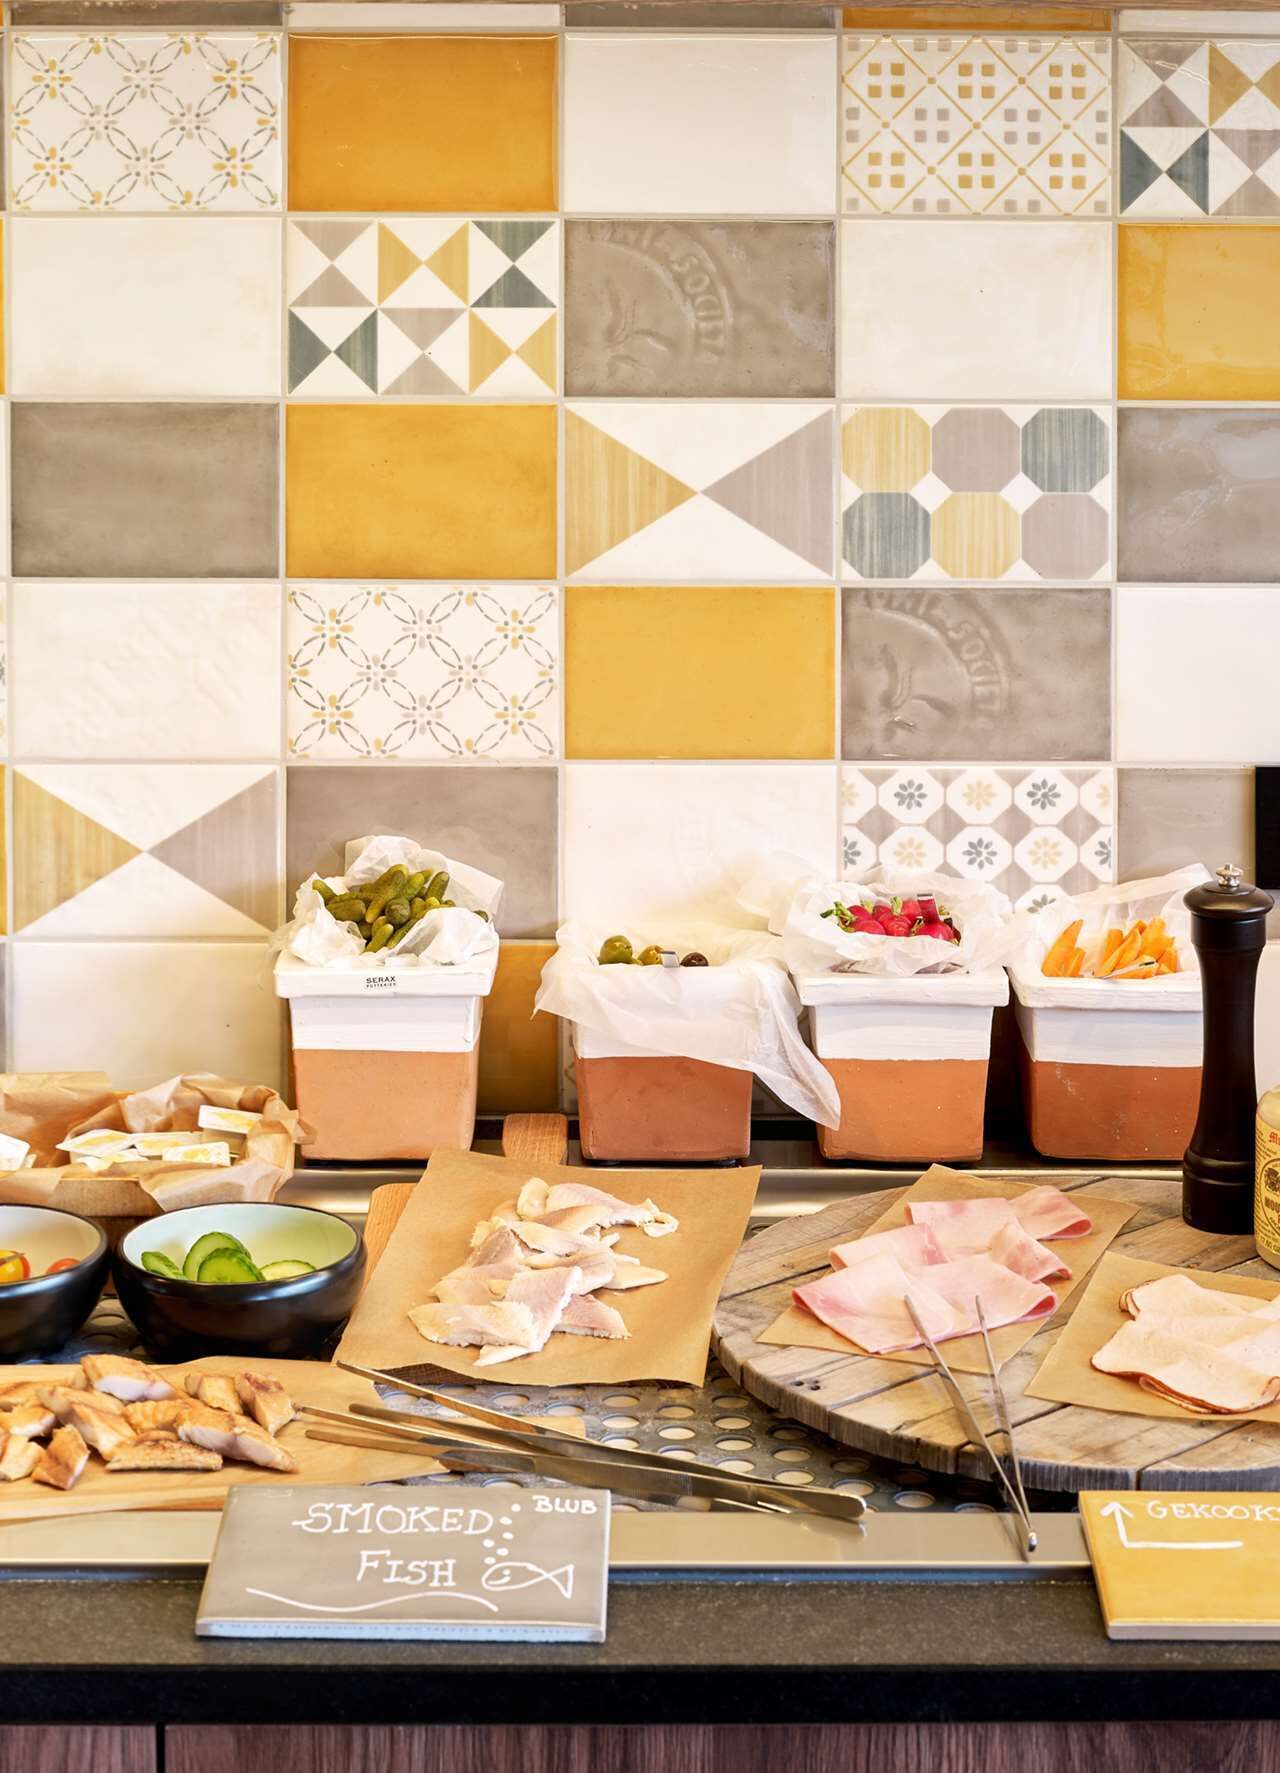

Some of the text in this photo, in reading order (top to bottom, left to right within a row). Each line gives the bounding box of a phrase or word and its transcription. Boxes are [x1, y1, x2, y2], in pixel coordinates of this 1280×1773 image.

[292, 1502, 495, 1536] SMOKED
[532, 1495, 598, 1515] BLUB
[357, 1549, 458, 1588] FISH
